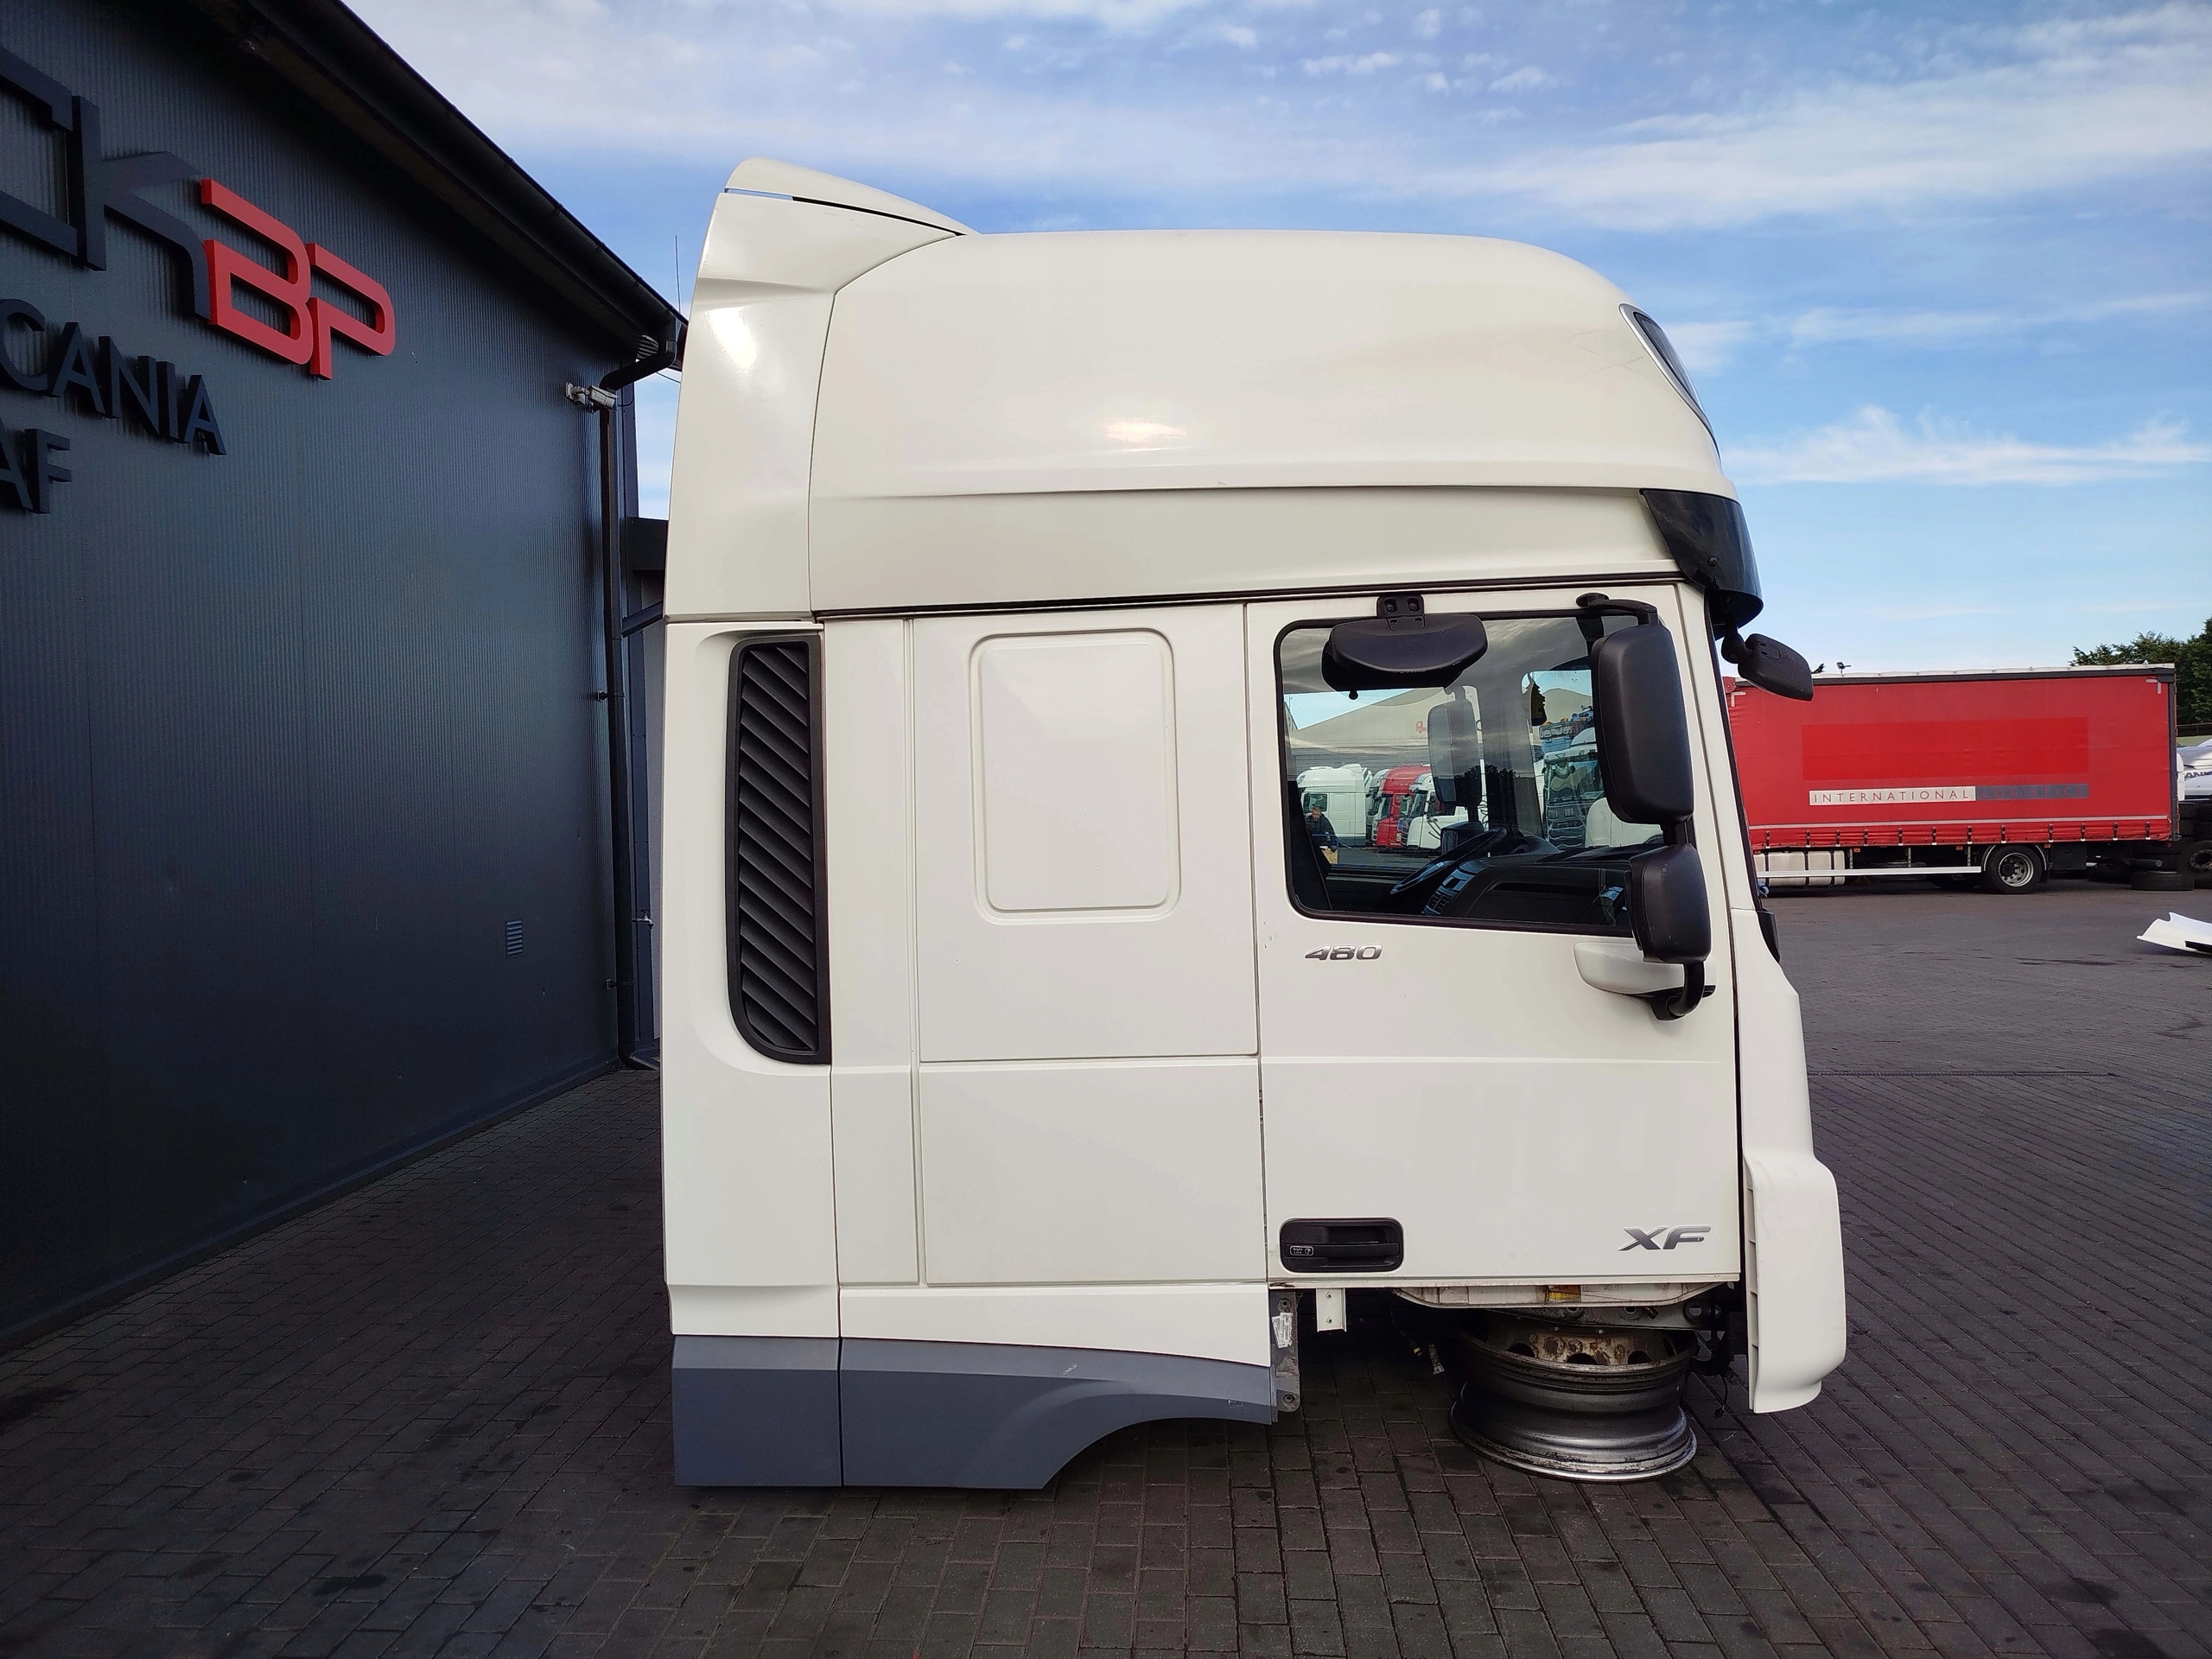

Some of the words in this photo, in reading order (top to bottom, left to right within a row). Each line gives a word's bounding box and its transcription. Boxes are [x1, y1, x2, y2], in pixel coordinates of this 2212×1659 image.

[1814, 790, 1970, 804] INTERNATIONAL
[1980, 786, 2083, 799] LOGISTICS
[1304, 944, 1382, 961] 480
[1618, 1225, 1712, 1251] XF
